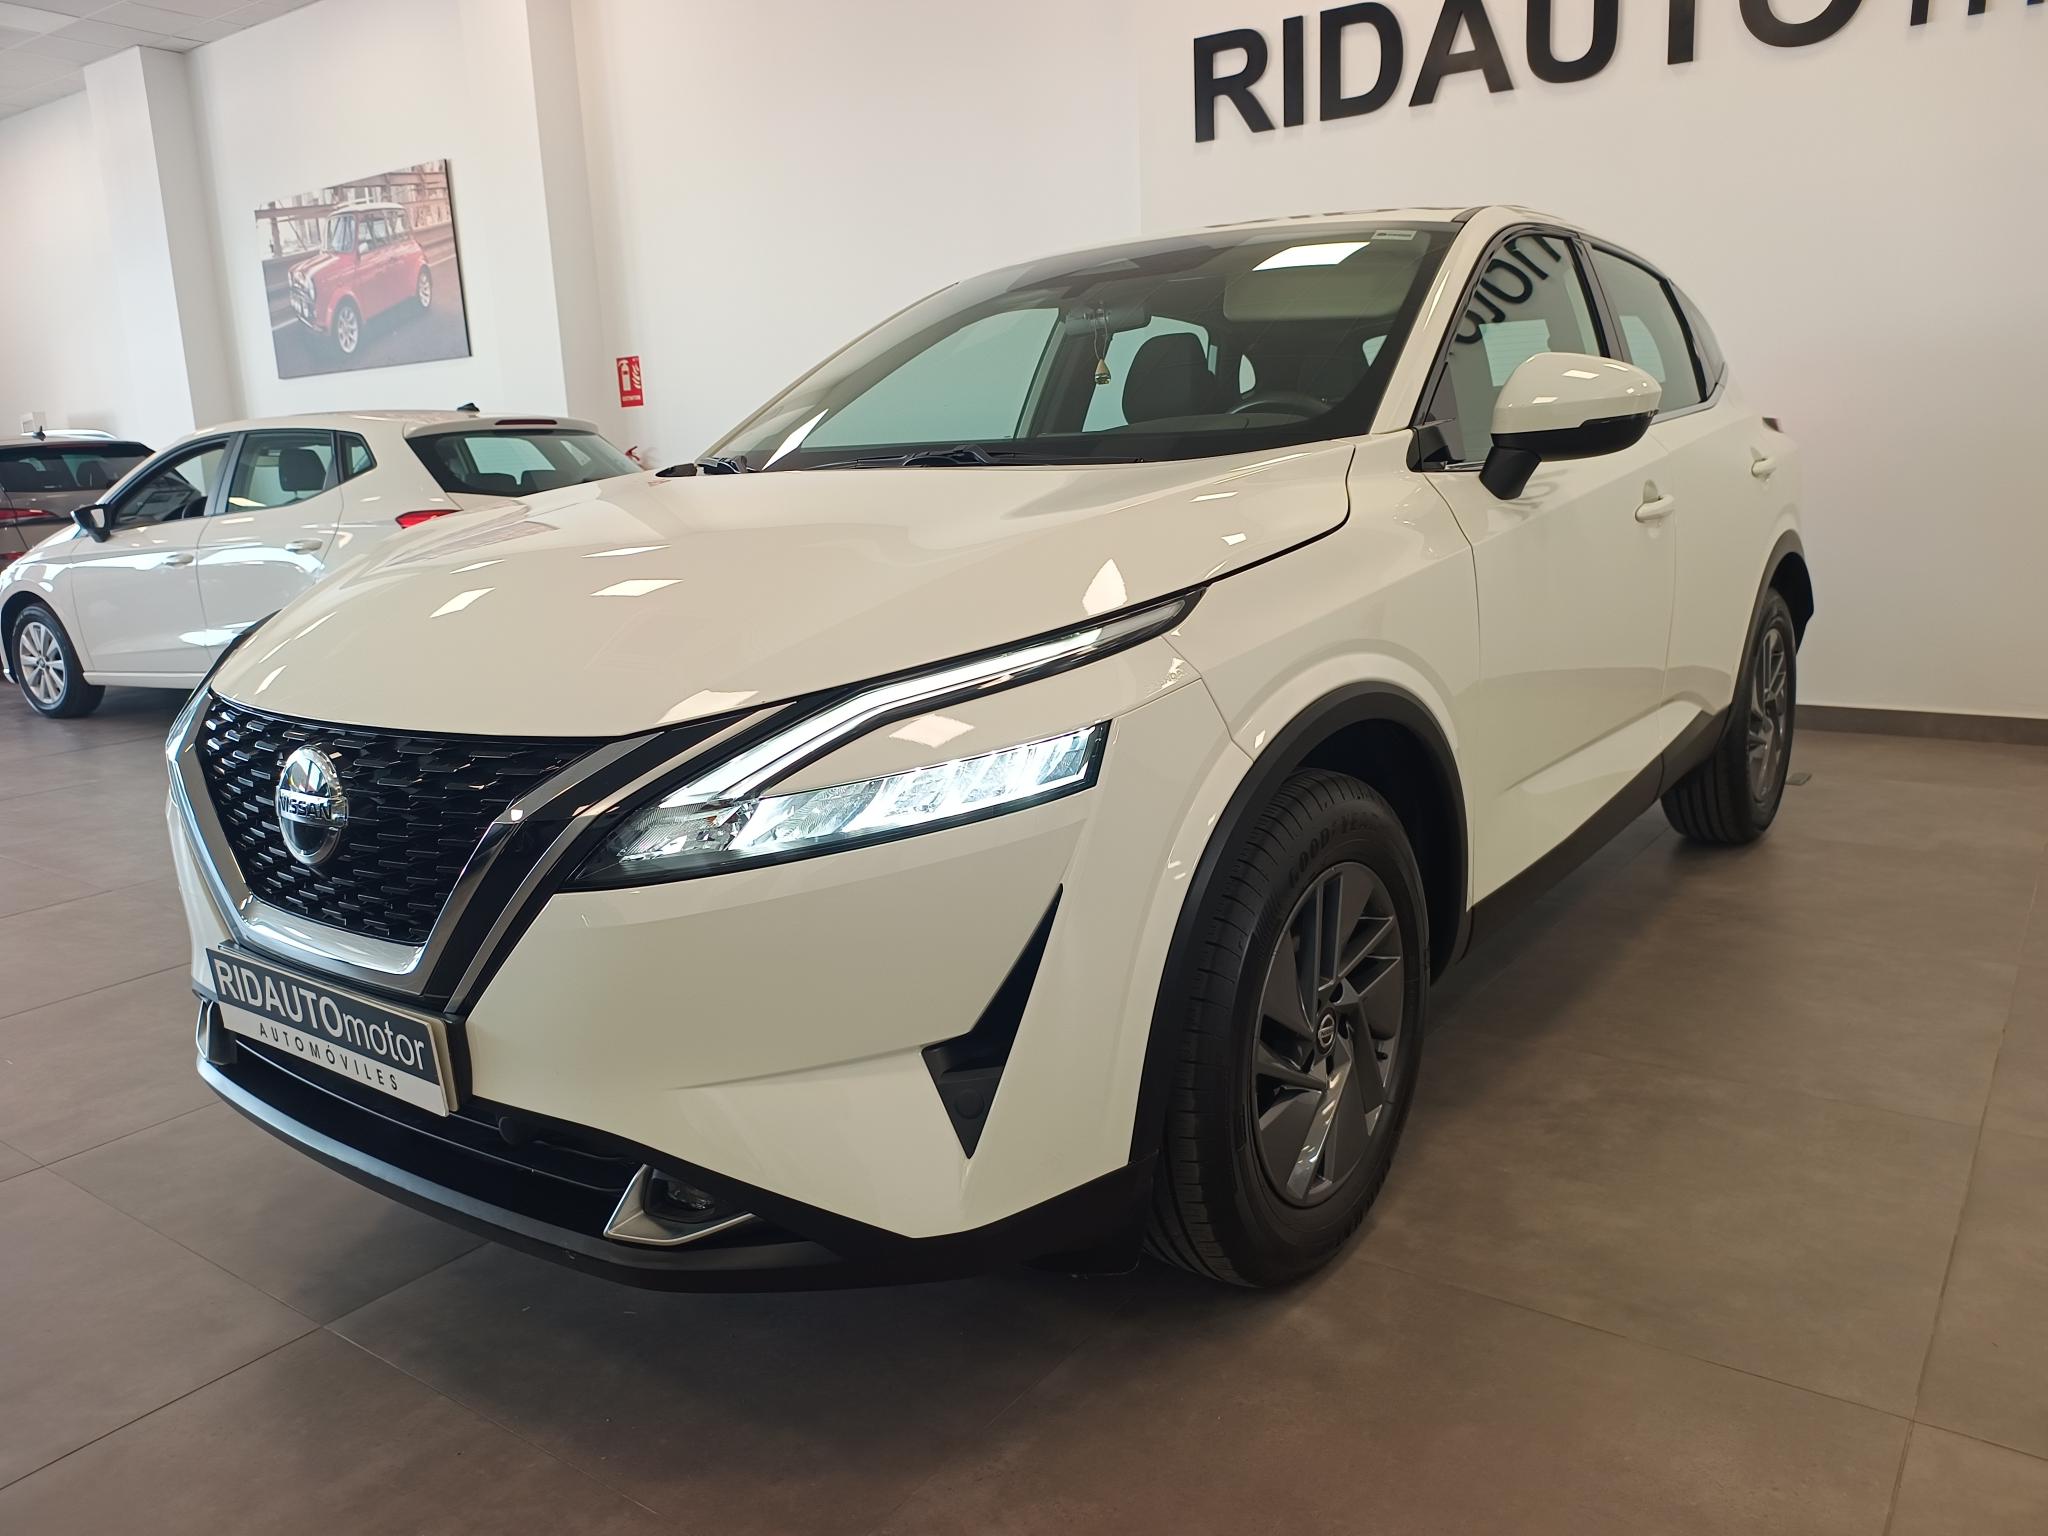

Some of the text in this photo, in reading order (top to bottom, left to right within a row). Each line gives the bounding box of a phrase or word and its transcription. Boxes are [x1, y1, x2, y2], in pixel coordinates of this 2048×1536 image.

[280, 796, 332, 820] NISSAN
[214, 958, 425, 1071] RIDAUTOmotor
[259, 1022, 399, 1092] AUTOMÓVILES
